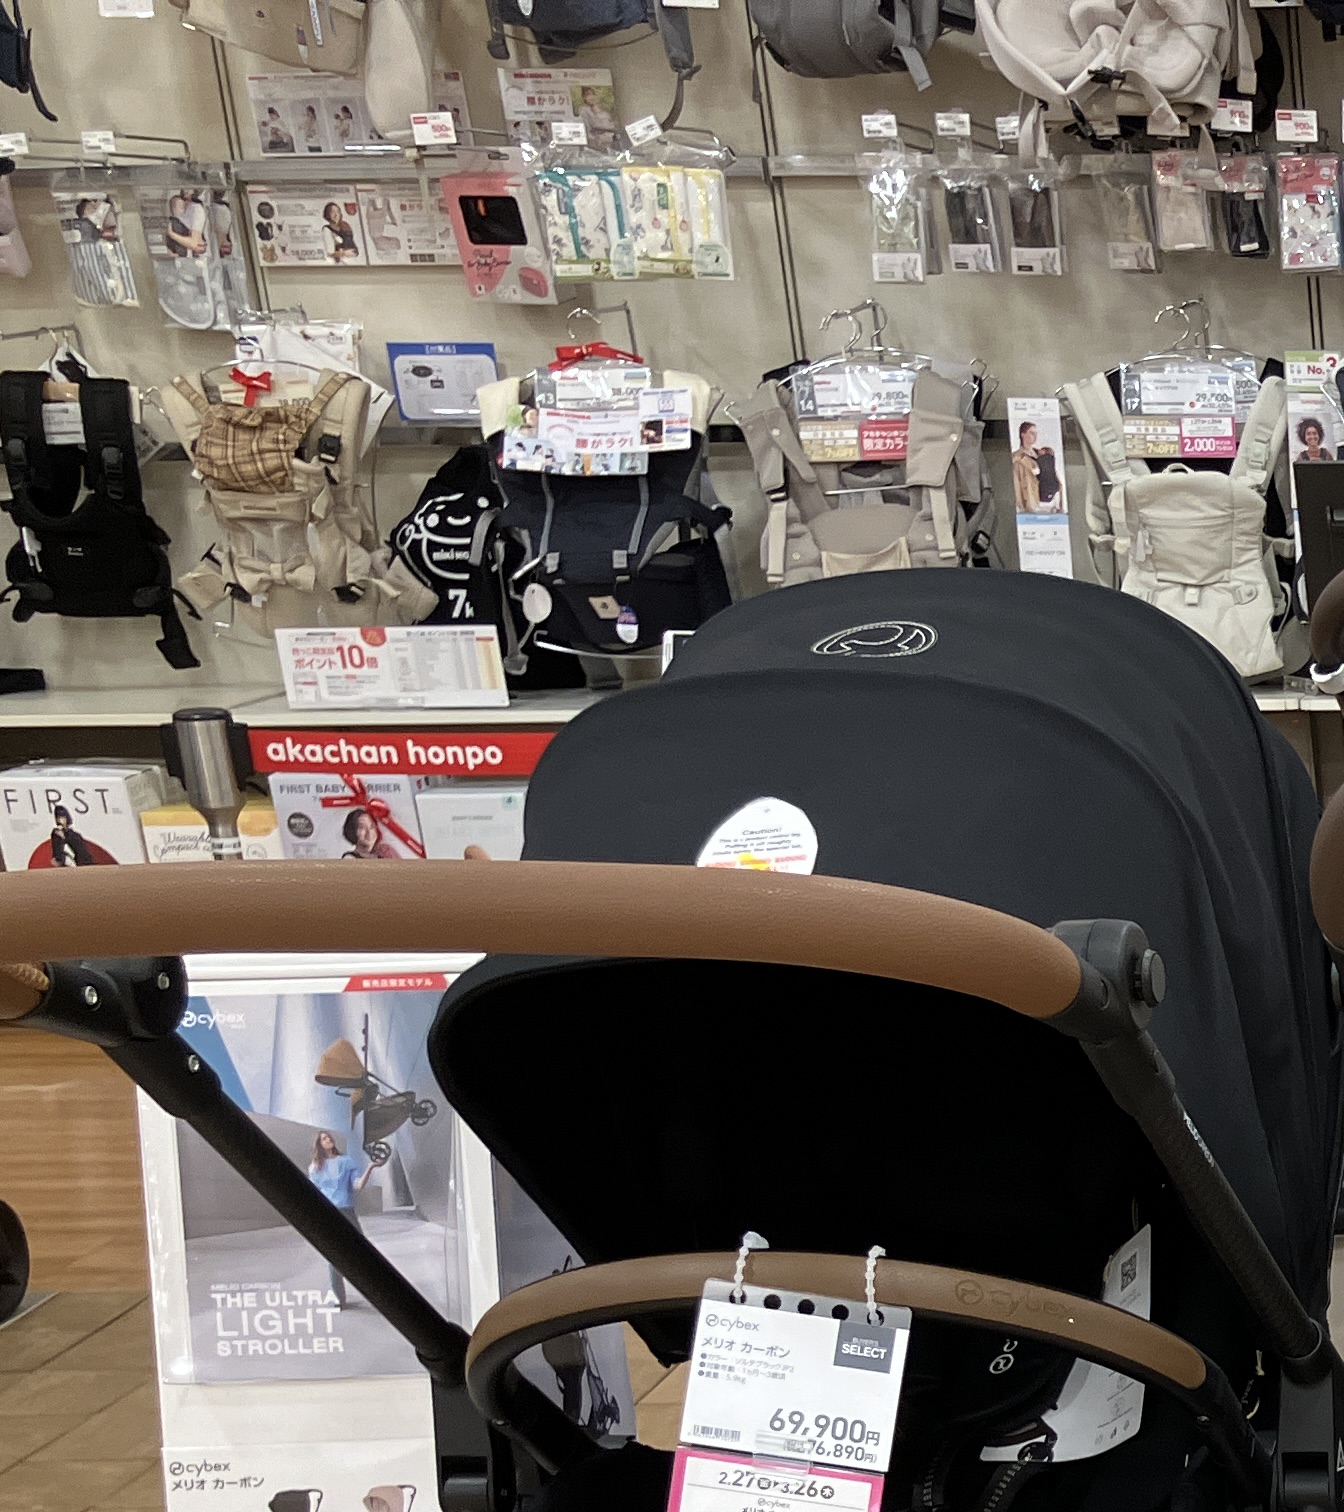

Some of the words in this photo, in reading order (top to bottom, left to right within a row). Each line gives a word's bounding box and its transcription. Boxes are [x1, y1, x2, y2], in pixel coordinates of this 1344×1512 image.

[267, 738, 400, 766] akachan
[406, 739, 504, 771] honpo
[279, 783, 313, 795] FIRST
[3, 787, 111, 817] FIRST
[198, 1011, 245, 1031] cybex
[211, 1291, 257, 1309] THE
[265, 1289, 340, 1307] ULTRA
[216, 1307, 342, 1337] LIGHT
[720, 1315, 760, 1331] cybex
[217, 1337, 345, 1357] STROLLER
[702, 1336, 736, 1351] メリオ
[740, 1341, 791, 1358] カーボン
[841, 1343, 888, 1360] SELECT
[769, 1408, 881, 1446] 69,900円
[186, 1459, 231, 1476] cybex
[171, 1478, 208, 1491] メリオ
[212, 1476, 265, 1489] カーボン
